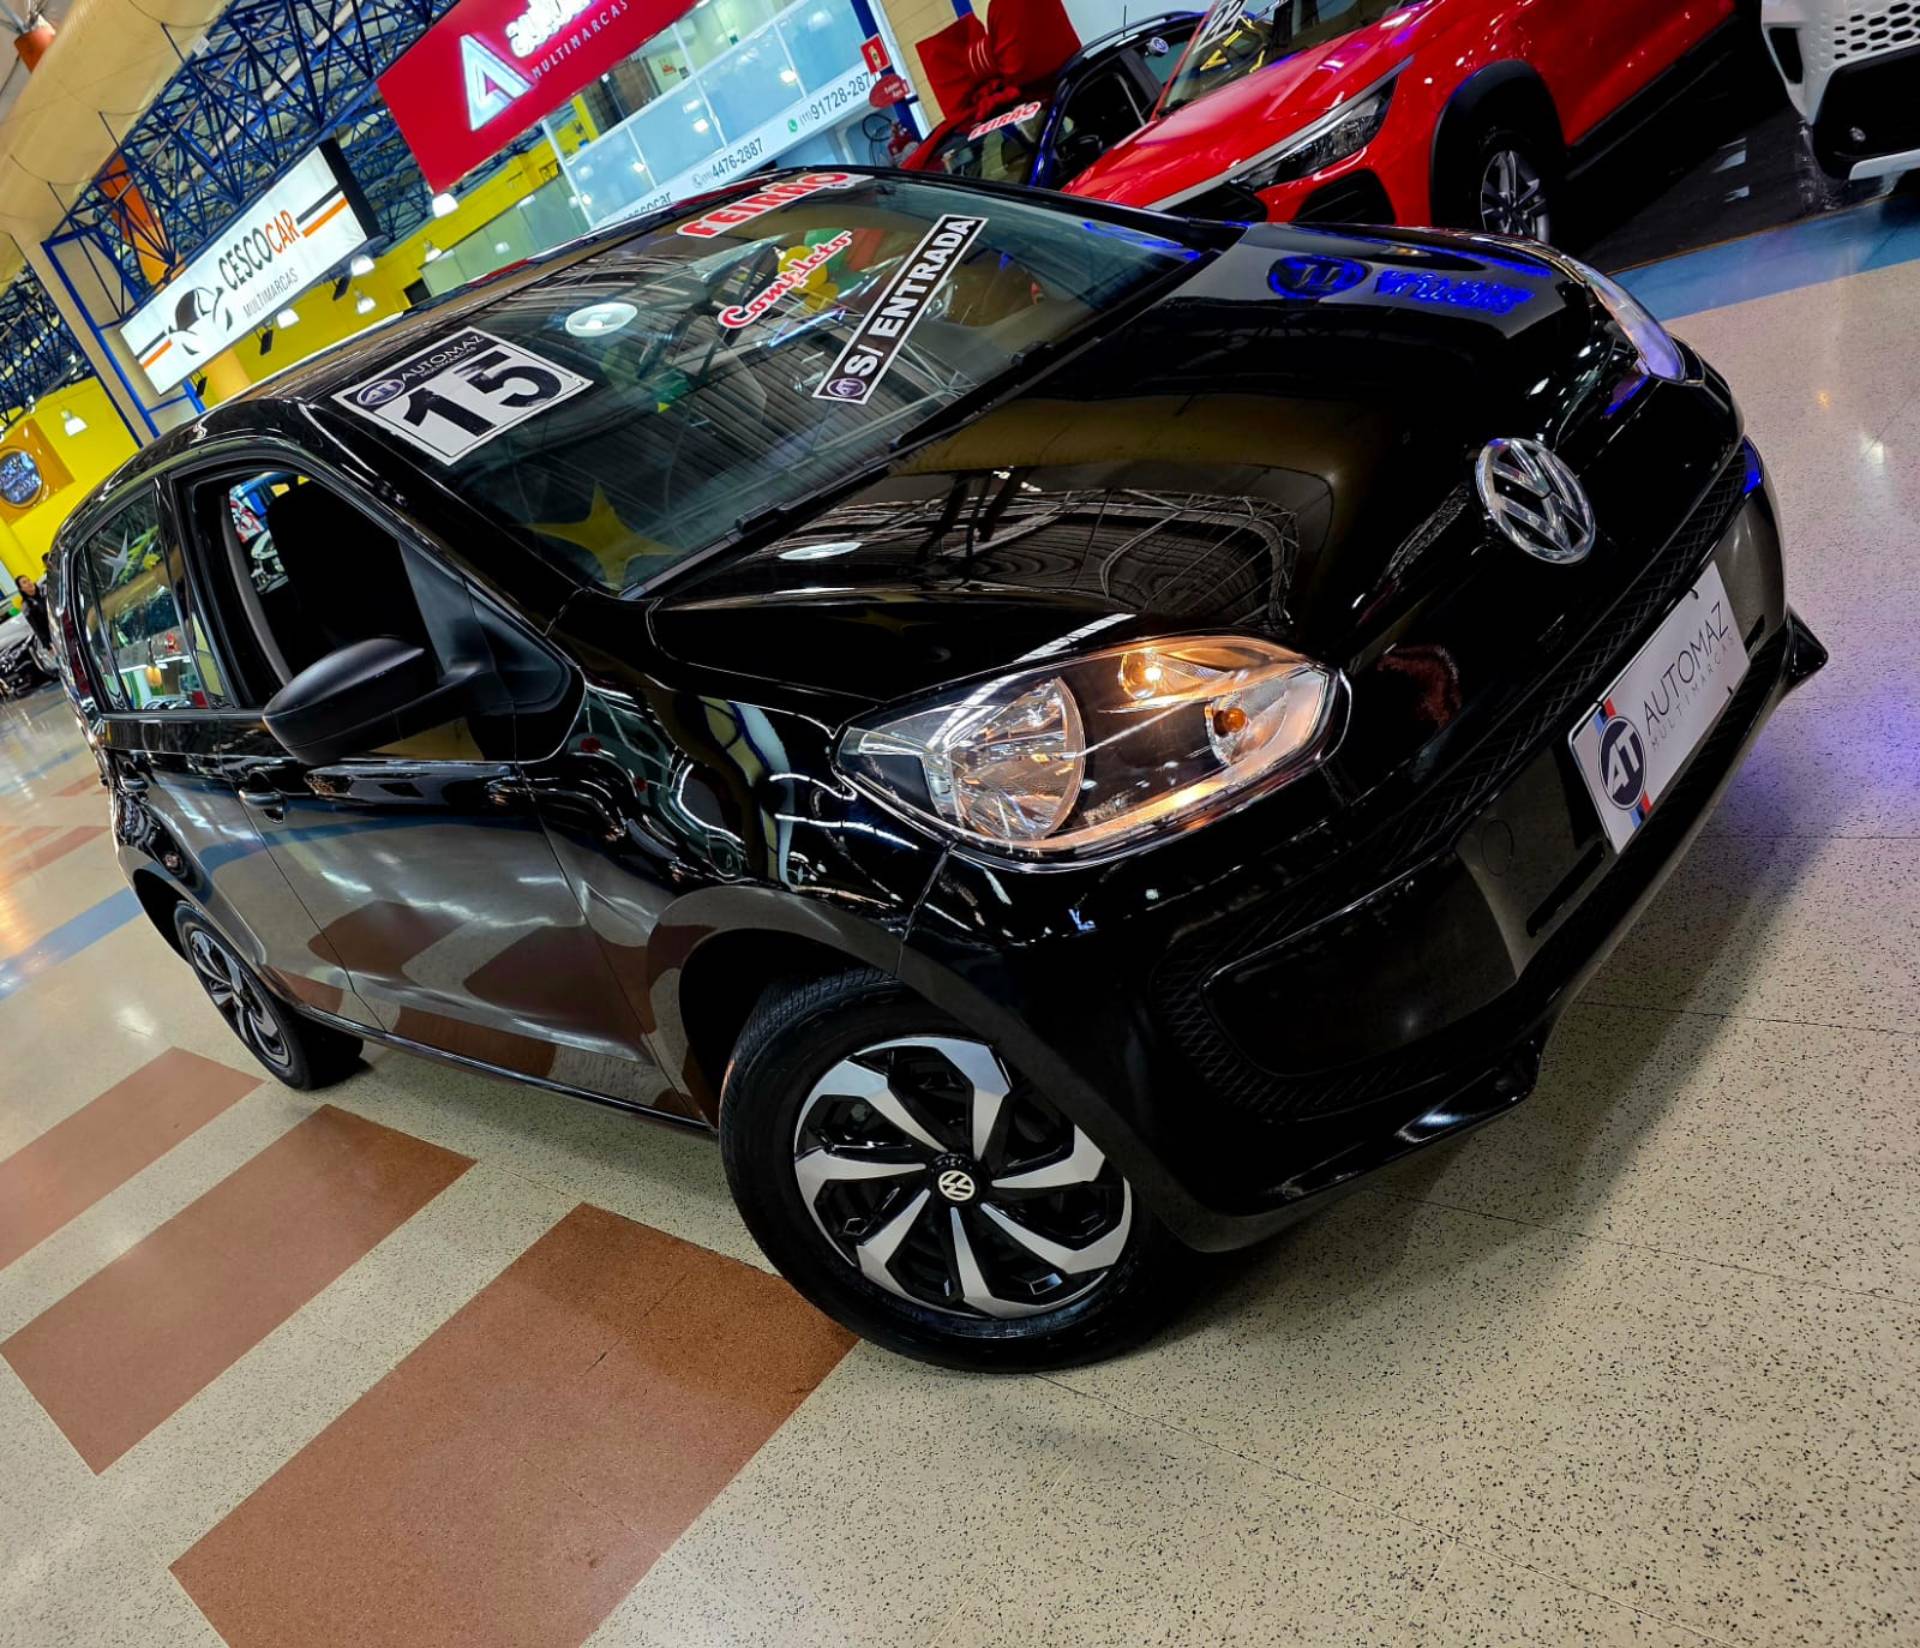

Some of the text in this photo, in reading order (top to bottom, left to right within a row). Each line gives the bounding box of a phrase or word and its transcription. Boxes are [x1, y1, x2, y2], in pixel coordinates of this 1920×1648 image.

[532, 0, 630, 79] MULTIMARCAS
[218, 210, 301, 291] CESCOCAR
[243, 268, 299, 318] MULTIMARCAS
[718, 231, 853, 328] Completo
[867, 219, 978, 339] ENTRADA
[401, 335, 485, 382] AUTOMAZ
[402, 349, 563, 438] 15
[1643, 602, 1730, 736] AUTOMAZ
[1650, 631, 1735, 753] MULTIMARCAS
